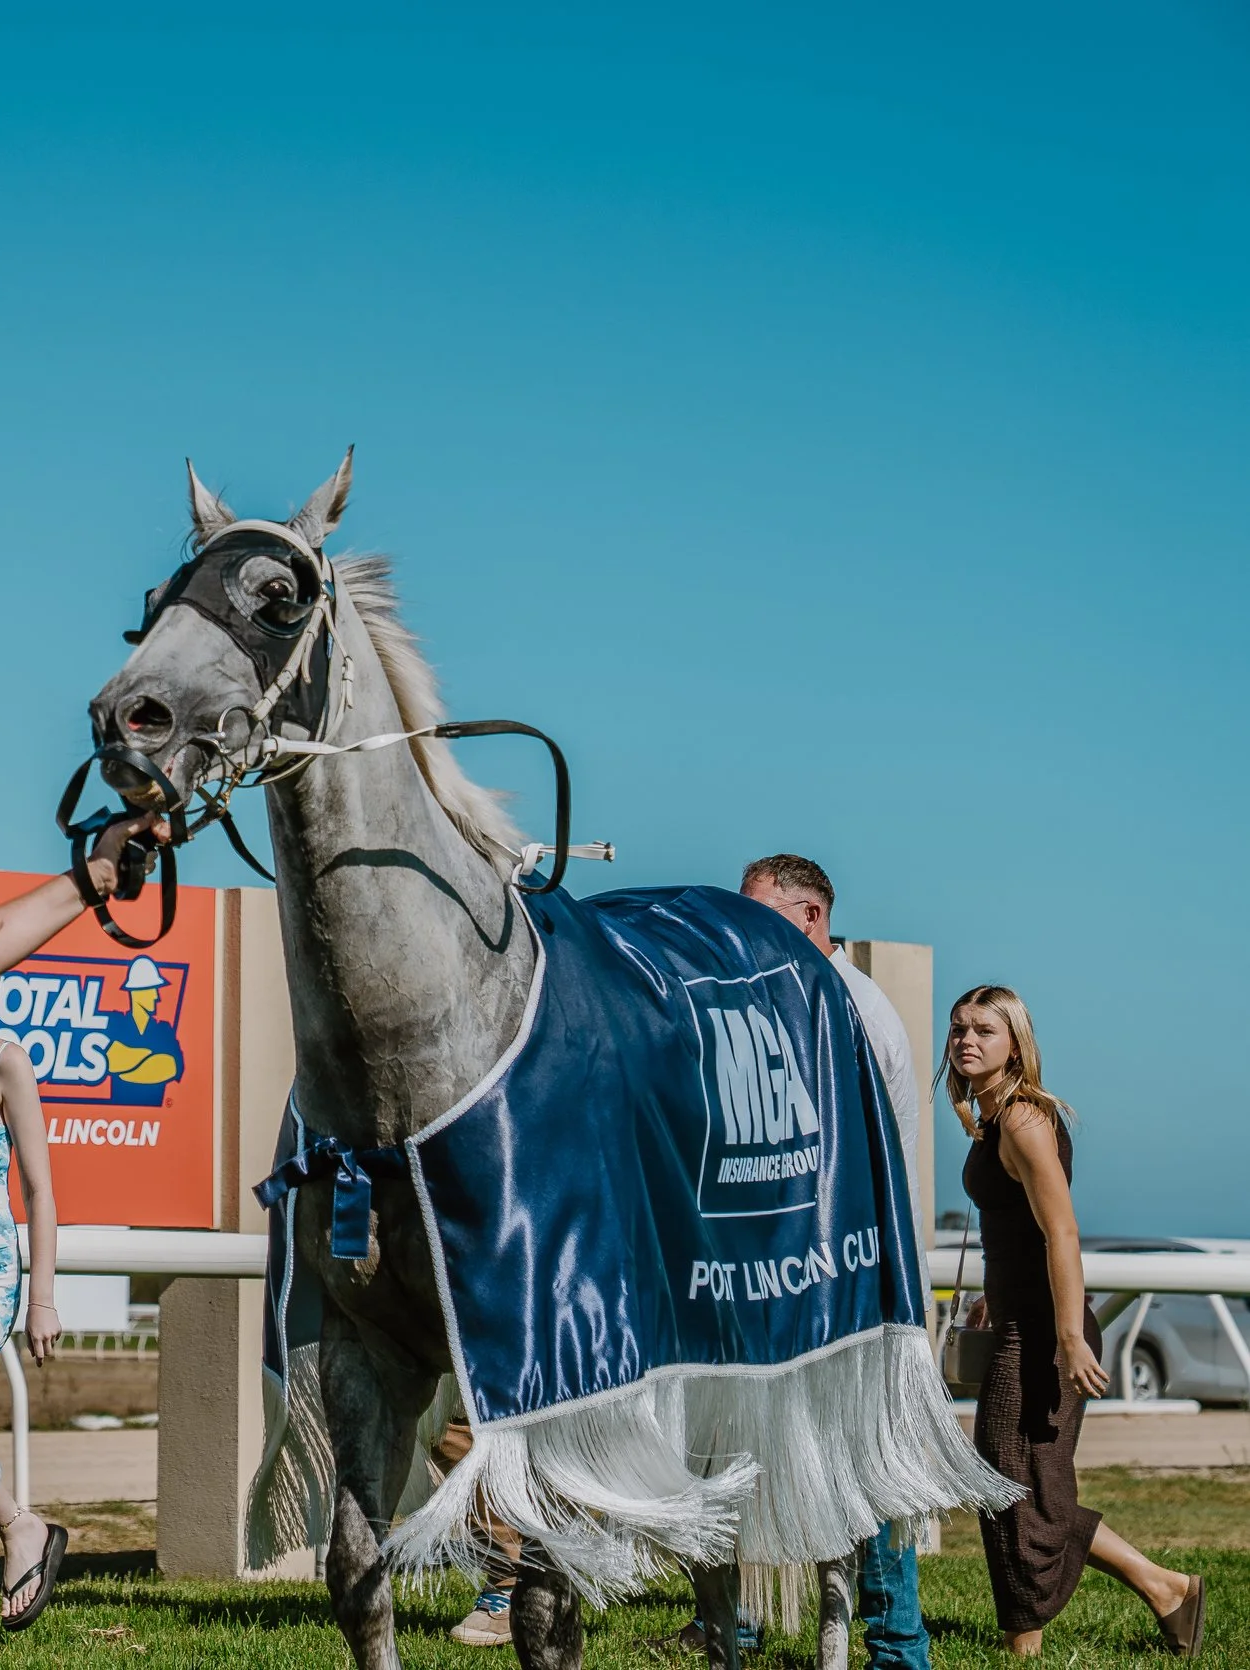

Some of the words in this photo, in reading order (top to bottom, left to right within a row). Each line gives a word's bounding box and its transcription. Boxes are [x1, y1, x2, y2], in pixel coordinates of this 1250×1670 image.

[707, 1004, 820, 1145] MGA
[47, 1118, 161, 1147] LINCOLN
[717, 1154, 781, 1184] INSURANCE
[781, 1145, 820, 1179] GROU
[688, 1260, 737, 1302] POT
[843, 1226, 880, 1272] CU
